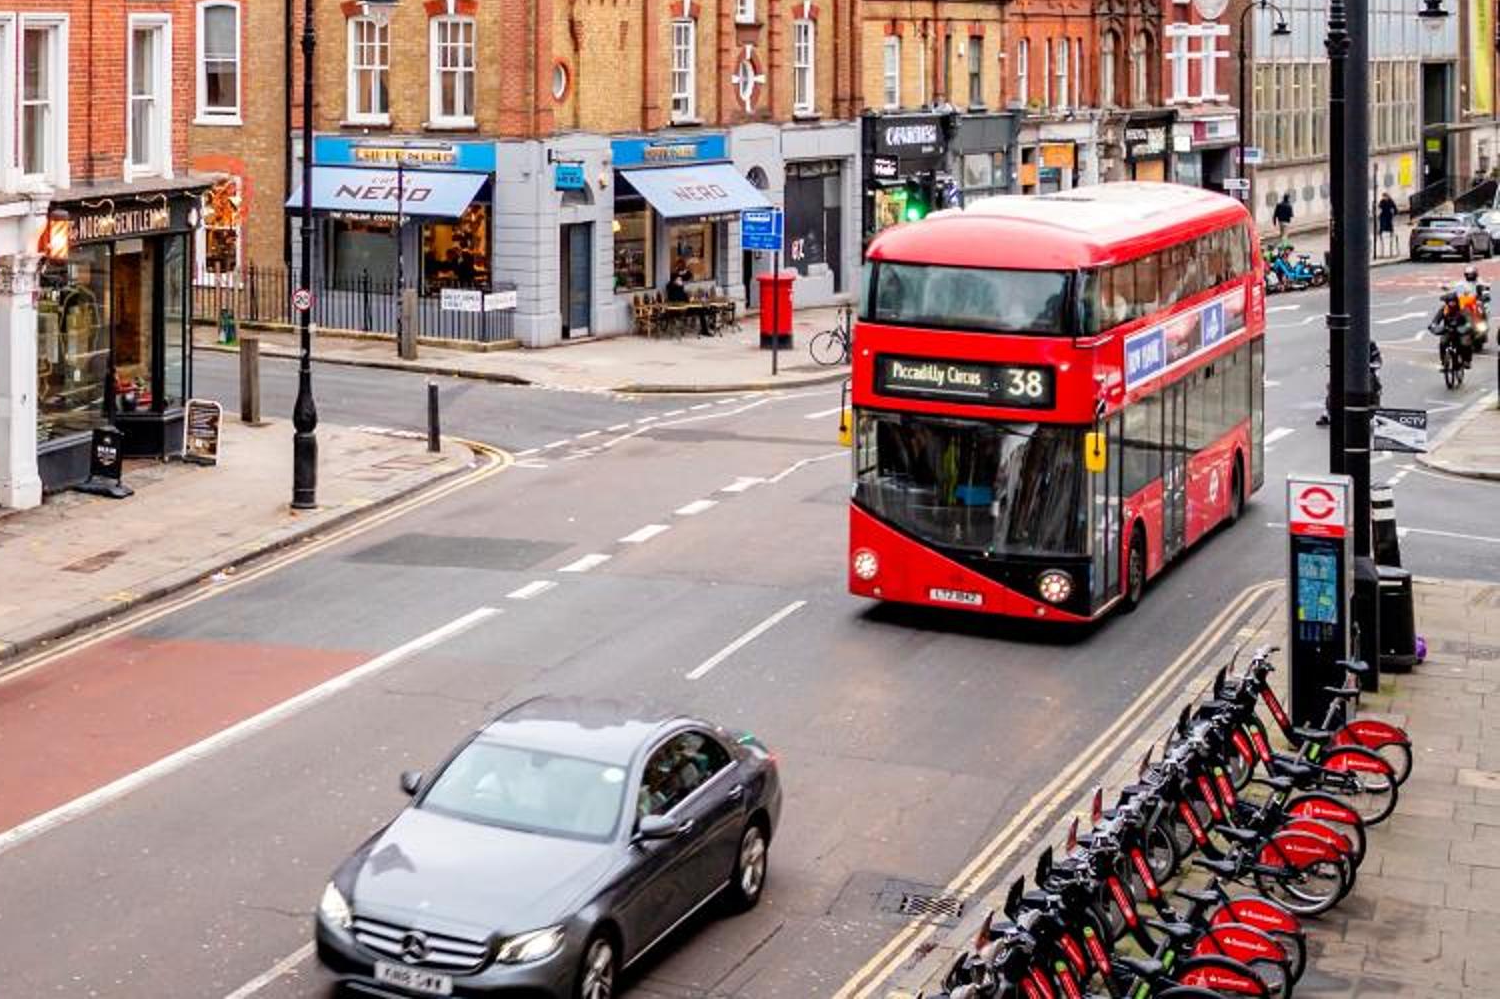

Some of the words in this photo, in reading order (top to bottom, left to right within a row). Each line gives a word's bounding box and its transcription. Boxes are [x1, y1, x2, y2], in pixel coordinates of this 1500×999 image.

[334, 184, 433, 203] NERO
[672, 184, 728, 201] NERO
[893, 361, 944, 387] Piccadilly
[947, 366, 981, 386] Circus
[1008, 369, 1044, 397] 38
[1399, 415, 1426, 426] CCTV
